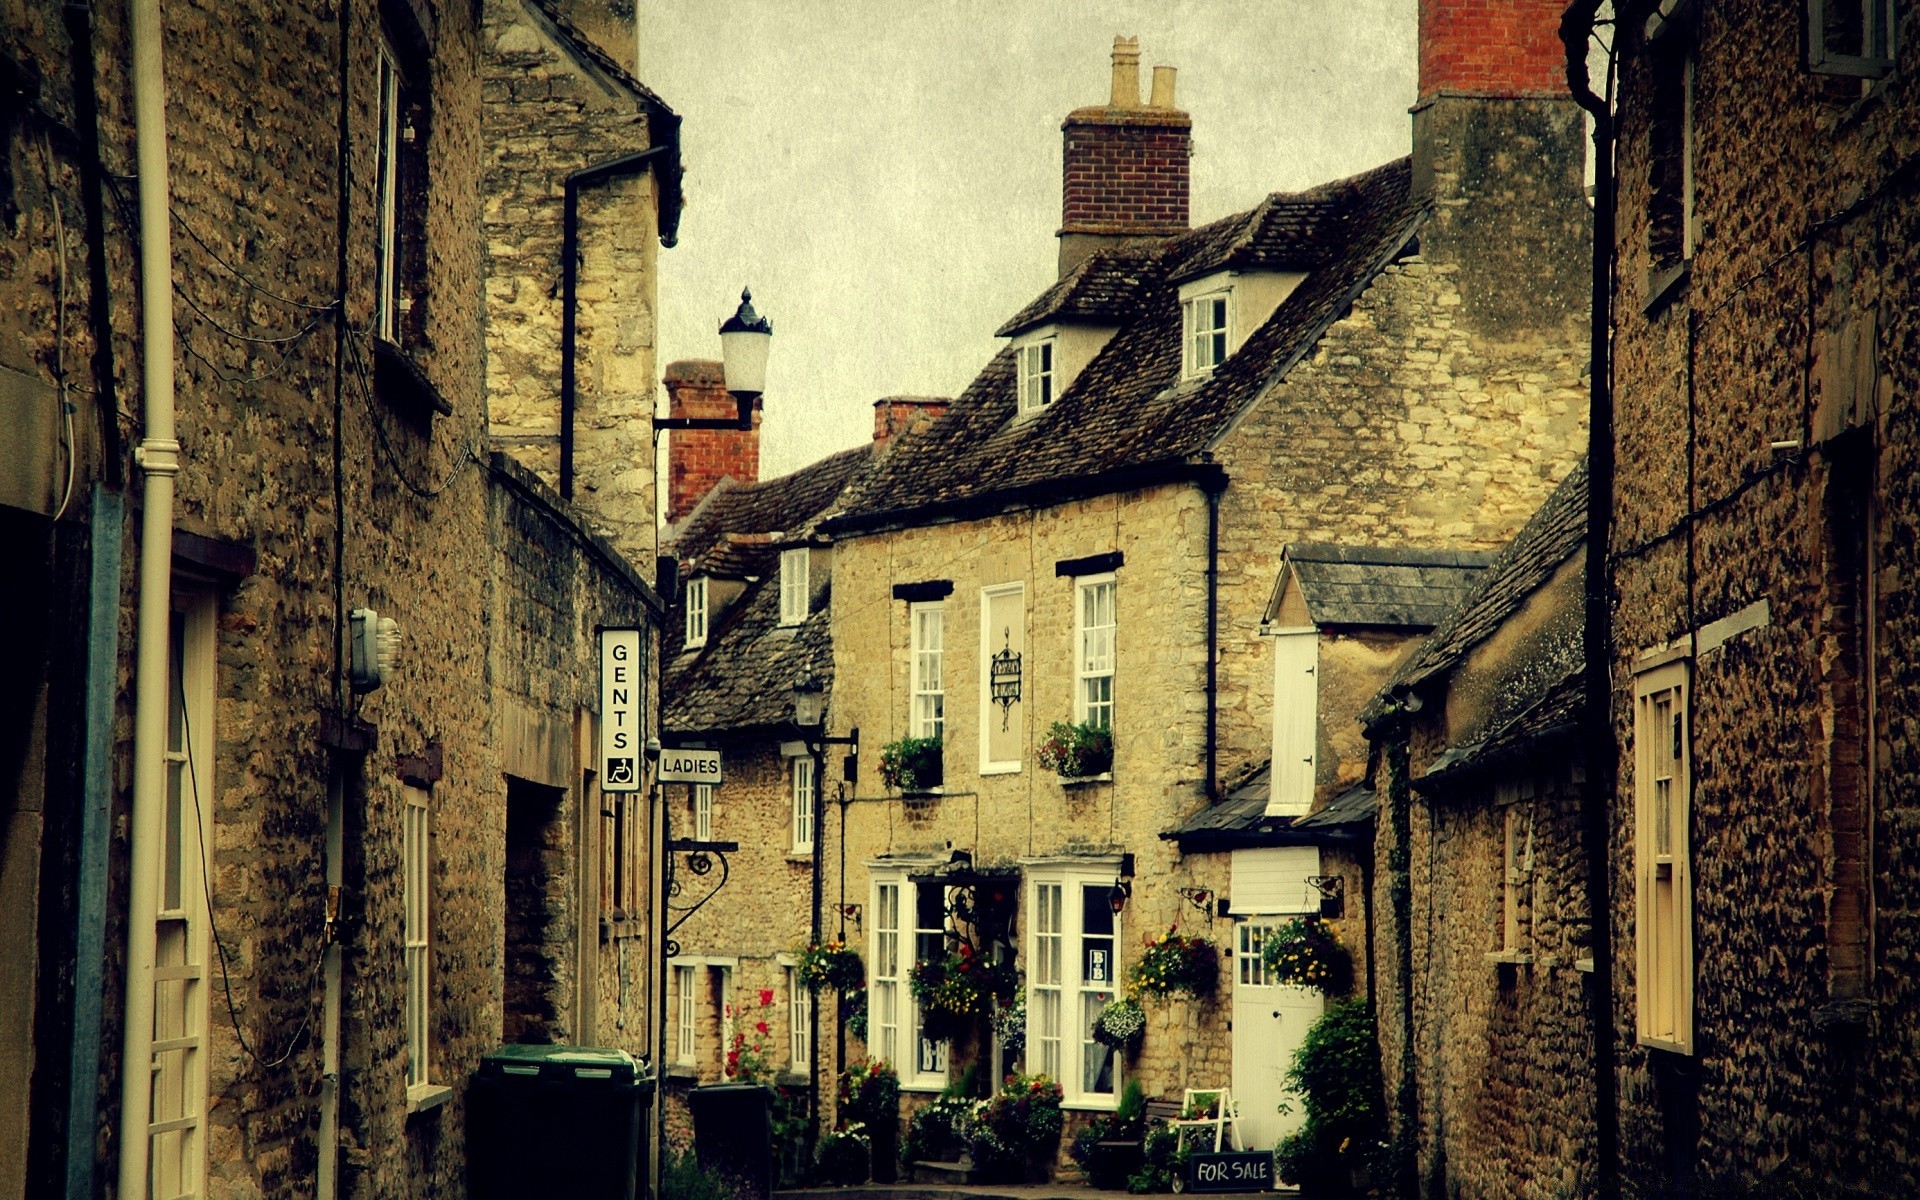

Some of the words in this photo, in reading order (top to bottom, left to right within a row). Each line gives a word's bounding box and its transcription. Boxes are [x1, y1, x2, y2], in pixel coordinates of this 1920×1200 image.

[613, 645, 627, 749] GENTS
[664, 758, 718, 774] LADIES
[1198, 1161, 1229, 1181] FOR
[1232, 1162, 1267, 1180] SALE
